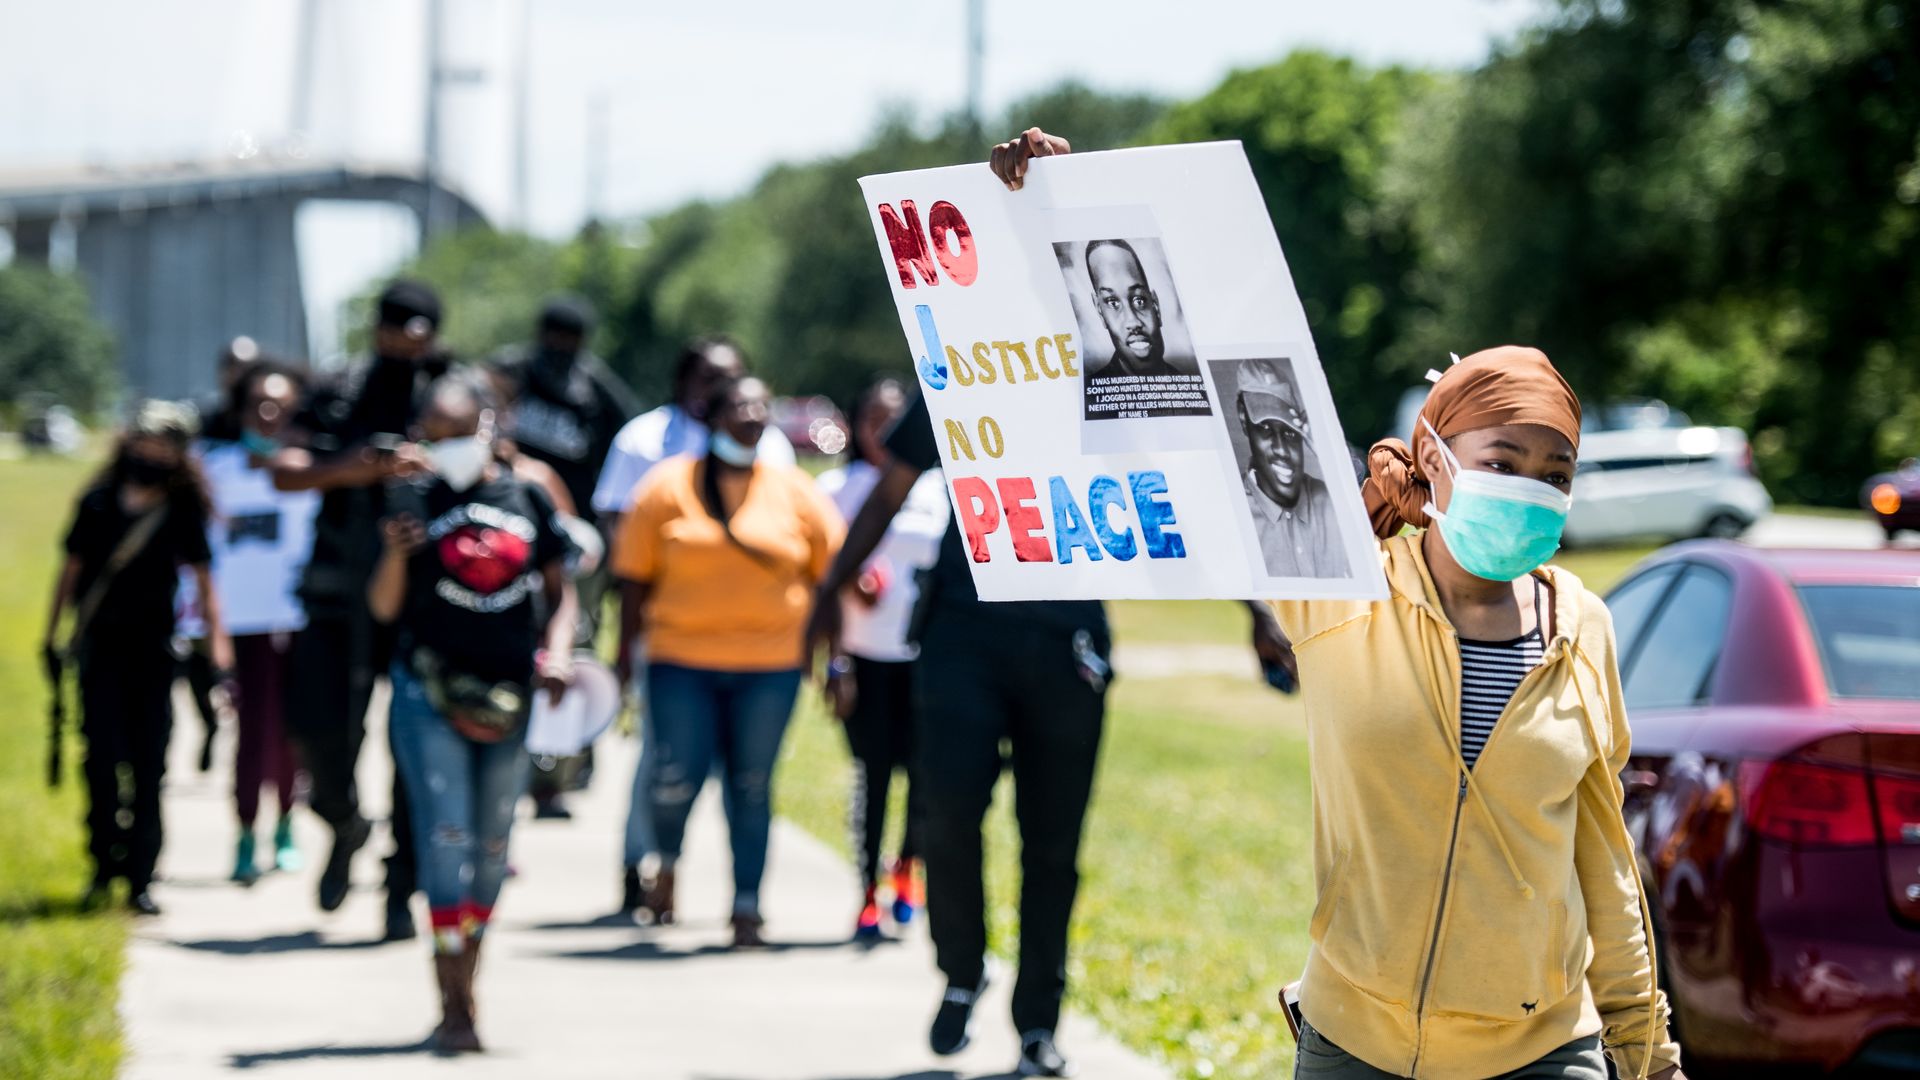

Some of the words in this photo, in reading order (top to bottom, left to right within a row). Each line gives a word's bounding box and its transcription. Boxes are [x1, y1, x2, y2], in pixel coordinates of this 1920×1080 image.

[878, 199, 979, 289] NO
[1095, 377, 1110, 385] WAS
[1110, 375, 1139, 384] MURDERED
[1139, 375, 1146, 383] BY
[1146, 375, 1155, 383] AN
[1155, 375, 1172, 383] ARMED
[1086, 386, 1104, 394] SON
[1104, 385, 1120, 393] WHO
[1120, 384, 1141, 392] HUNTED
[1100, 393, 1126, 402] JOGGED
[1126, 393, 1132, 401] IN
[1132, 393, 1137, 401] A
[1137, 392, 1162, 400] GEORGIA
[1088, 403, 1119, 411] NEITHER
[1119, 402, 1128, 410] OF
[1136, 401, 1158, 409] KILLERS
[1128, 410, 1143, 418] NAME
[944, 416, 1005, 461] NO
[952, 471, 1187, 564] PEACE
